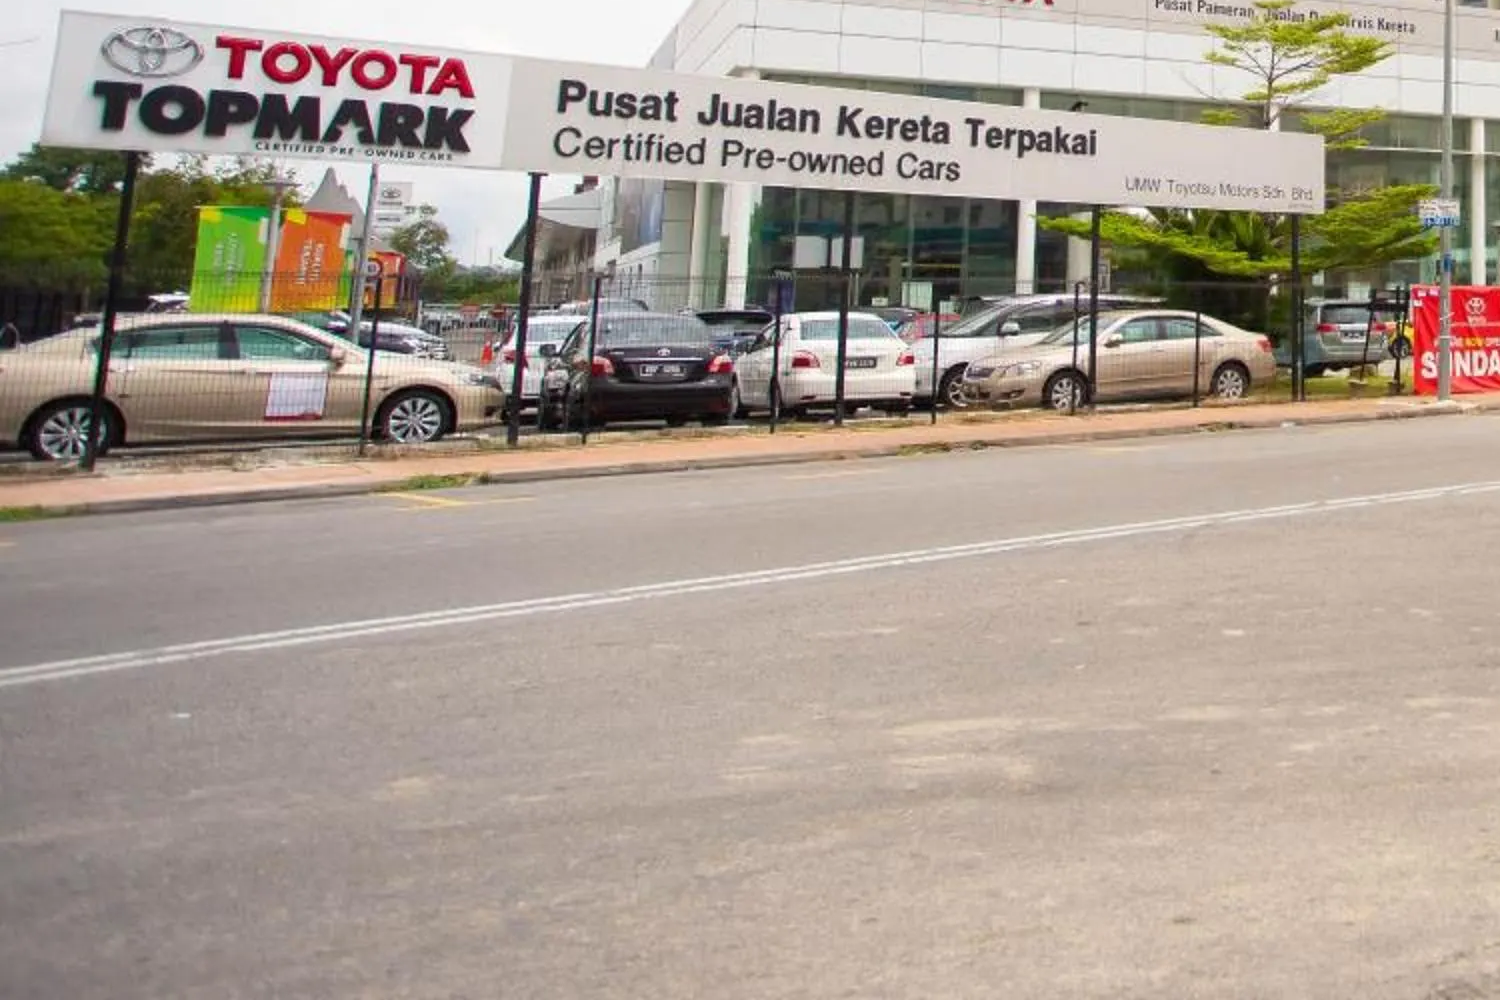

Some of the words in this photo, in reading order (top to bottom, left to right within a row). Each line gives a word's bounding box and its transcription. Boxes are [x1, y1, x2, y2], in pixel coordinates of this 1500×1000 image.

[1377, 17, 1416, 35] Kereta
[215, 35, 475, 98] TOYOTA
[94, 80, 476, 153] TOPMARK
[557, 79, 680, 122] Pusat
[698, 93, 821, 133] Jualan
[837, 105, 950, 144] Kereta
[965, 117, 1098, 159] Terpakai
[255, 141, 325, 154] CERTIFIED
[553, 126, 707, 165] Certified
[720, 139, 884, 176] Pre-owned
[896, 151, 961, 182] Cars
[1126, 176, 1161, 193] UMW
[1219, 183, 1259, 198] Motors
